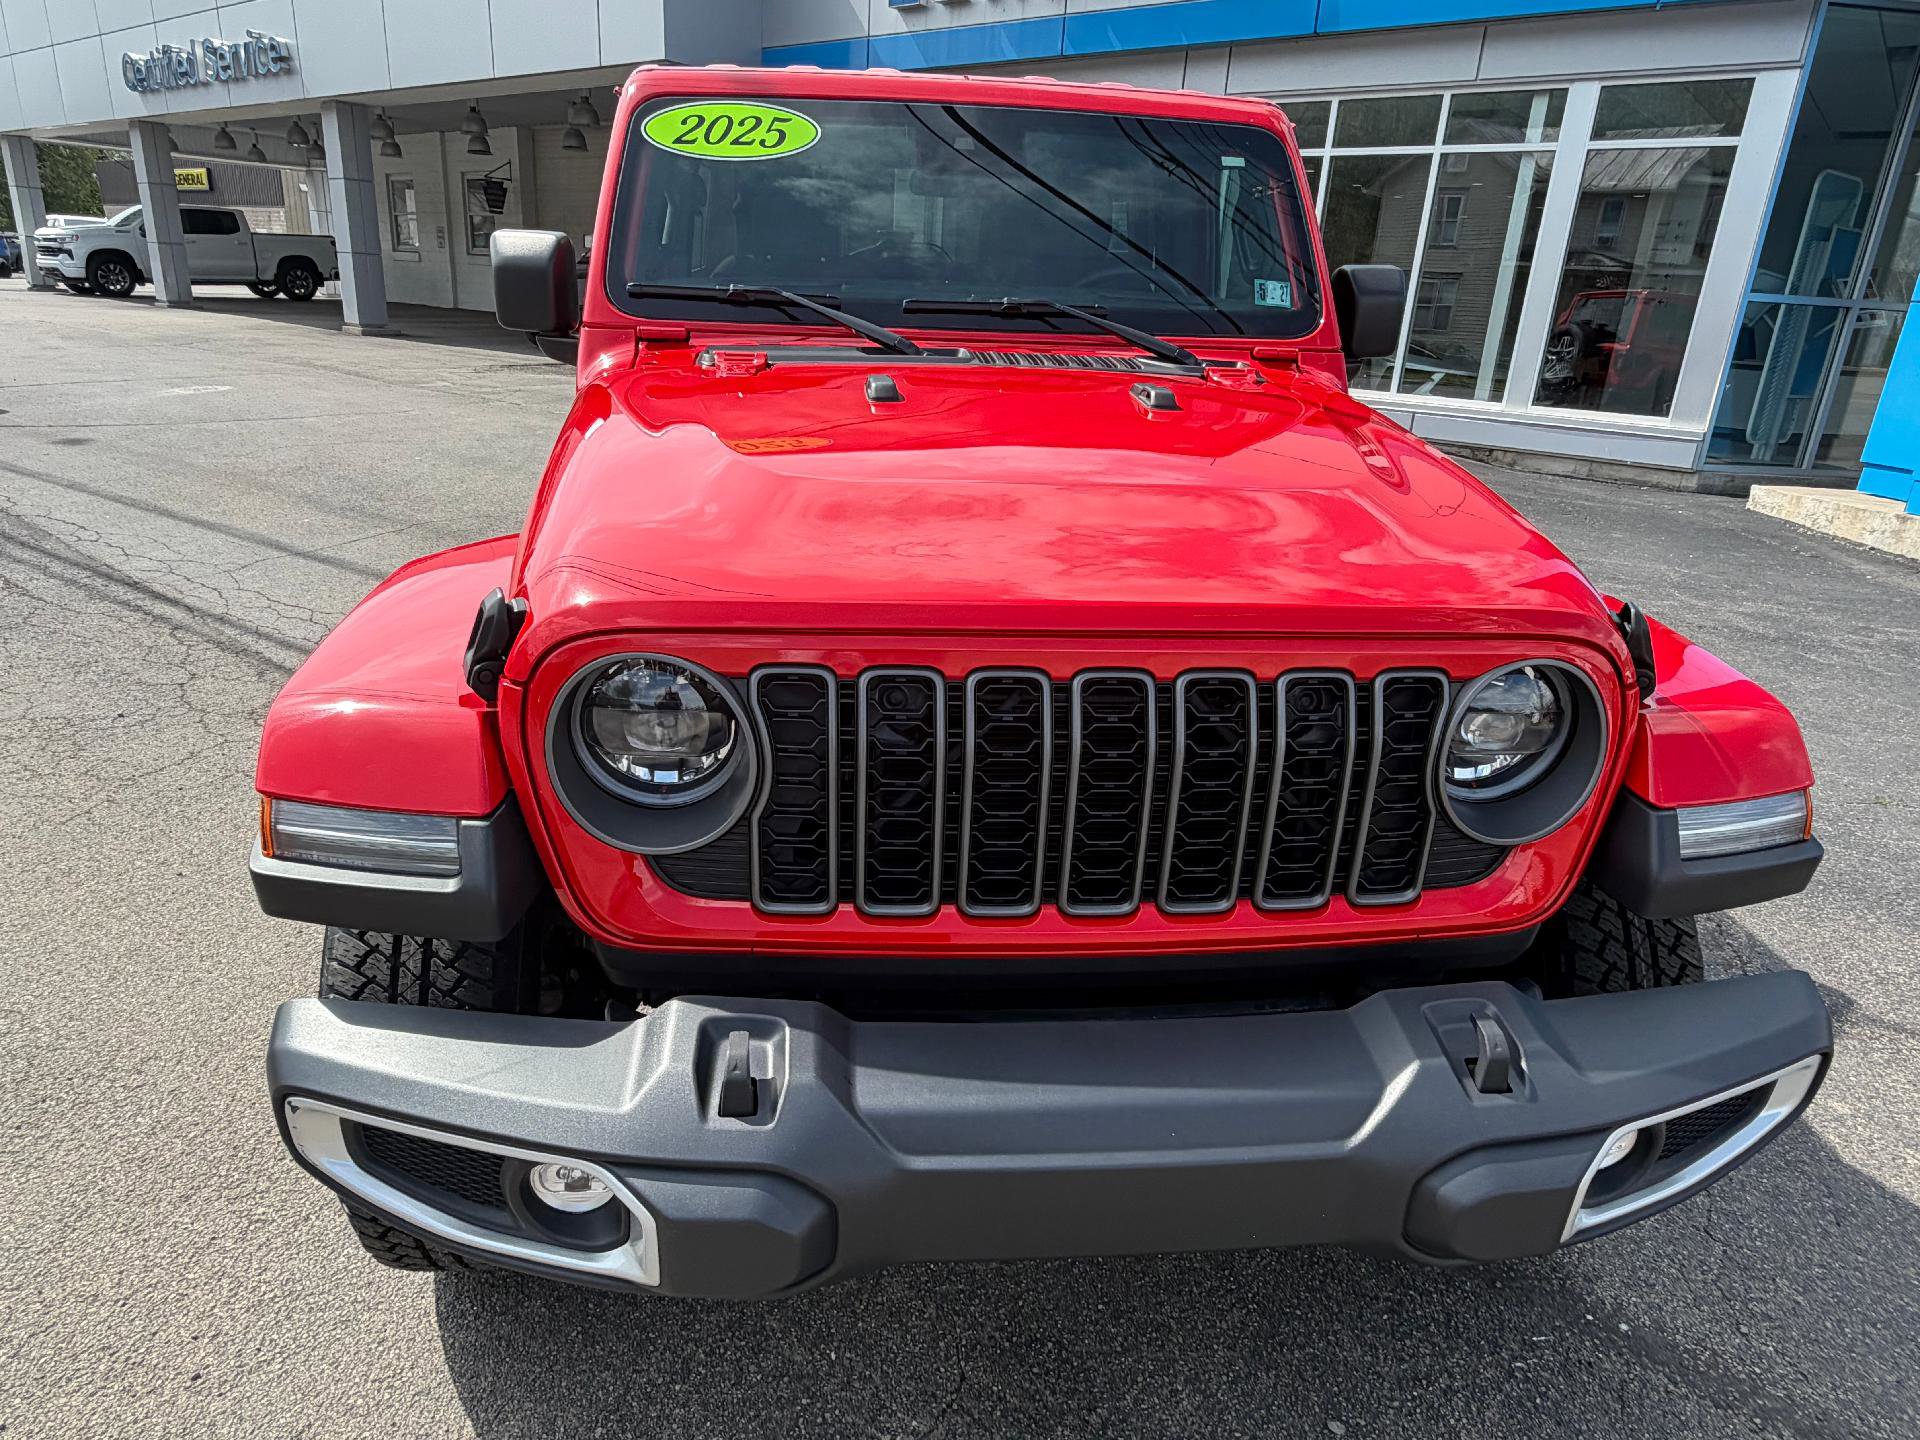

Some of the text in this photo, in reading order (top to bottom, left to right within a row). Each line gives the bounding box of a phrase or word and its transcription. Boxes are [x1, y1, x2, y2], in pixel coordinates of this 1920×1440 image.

[122, 29, 291, 92] Certified Service
[671, 114, 793, 149] 2025
